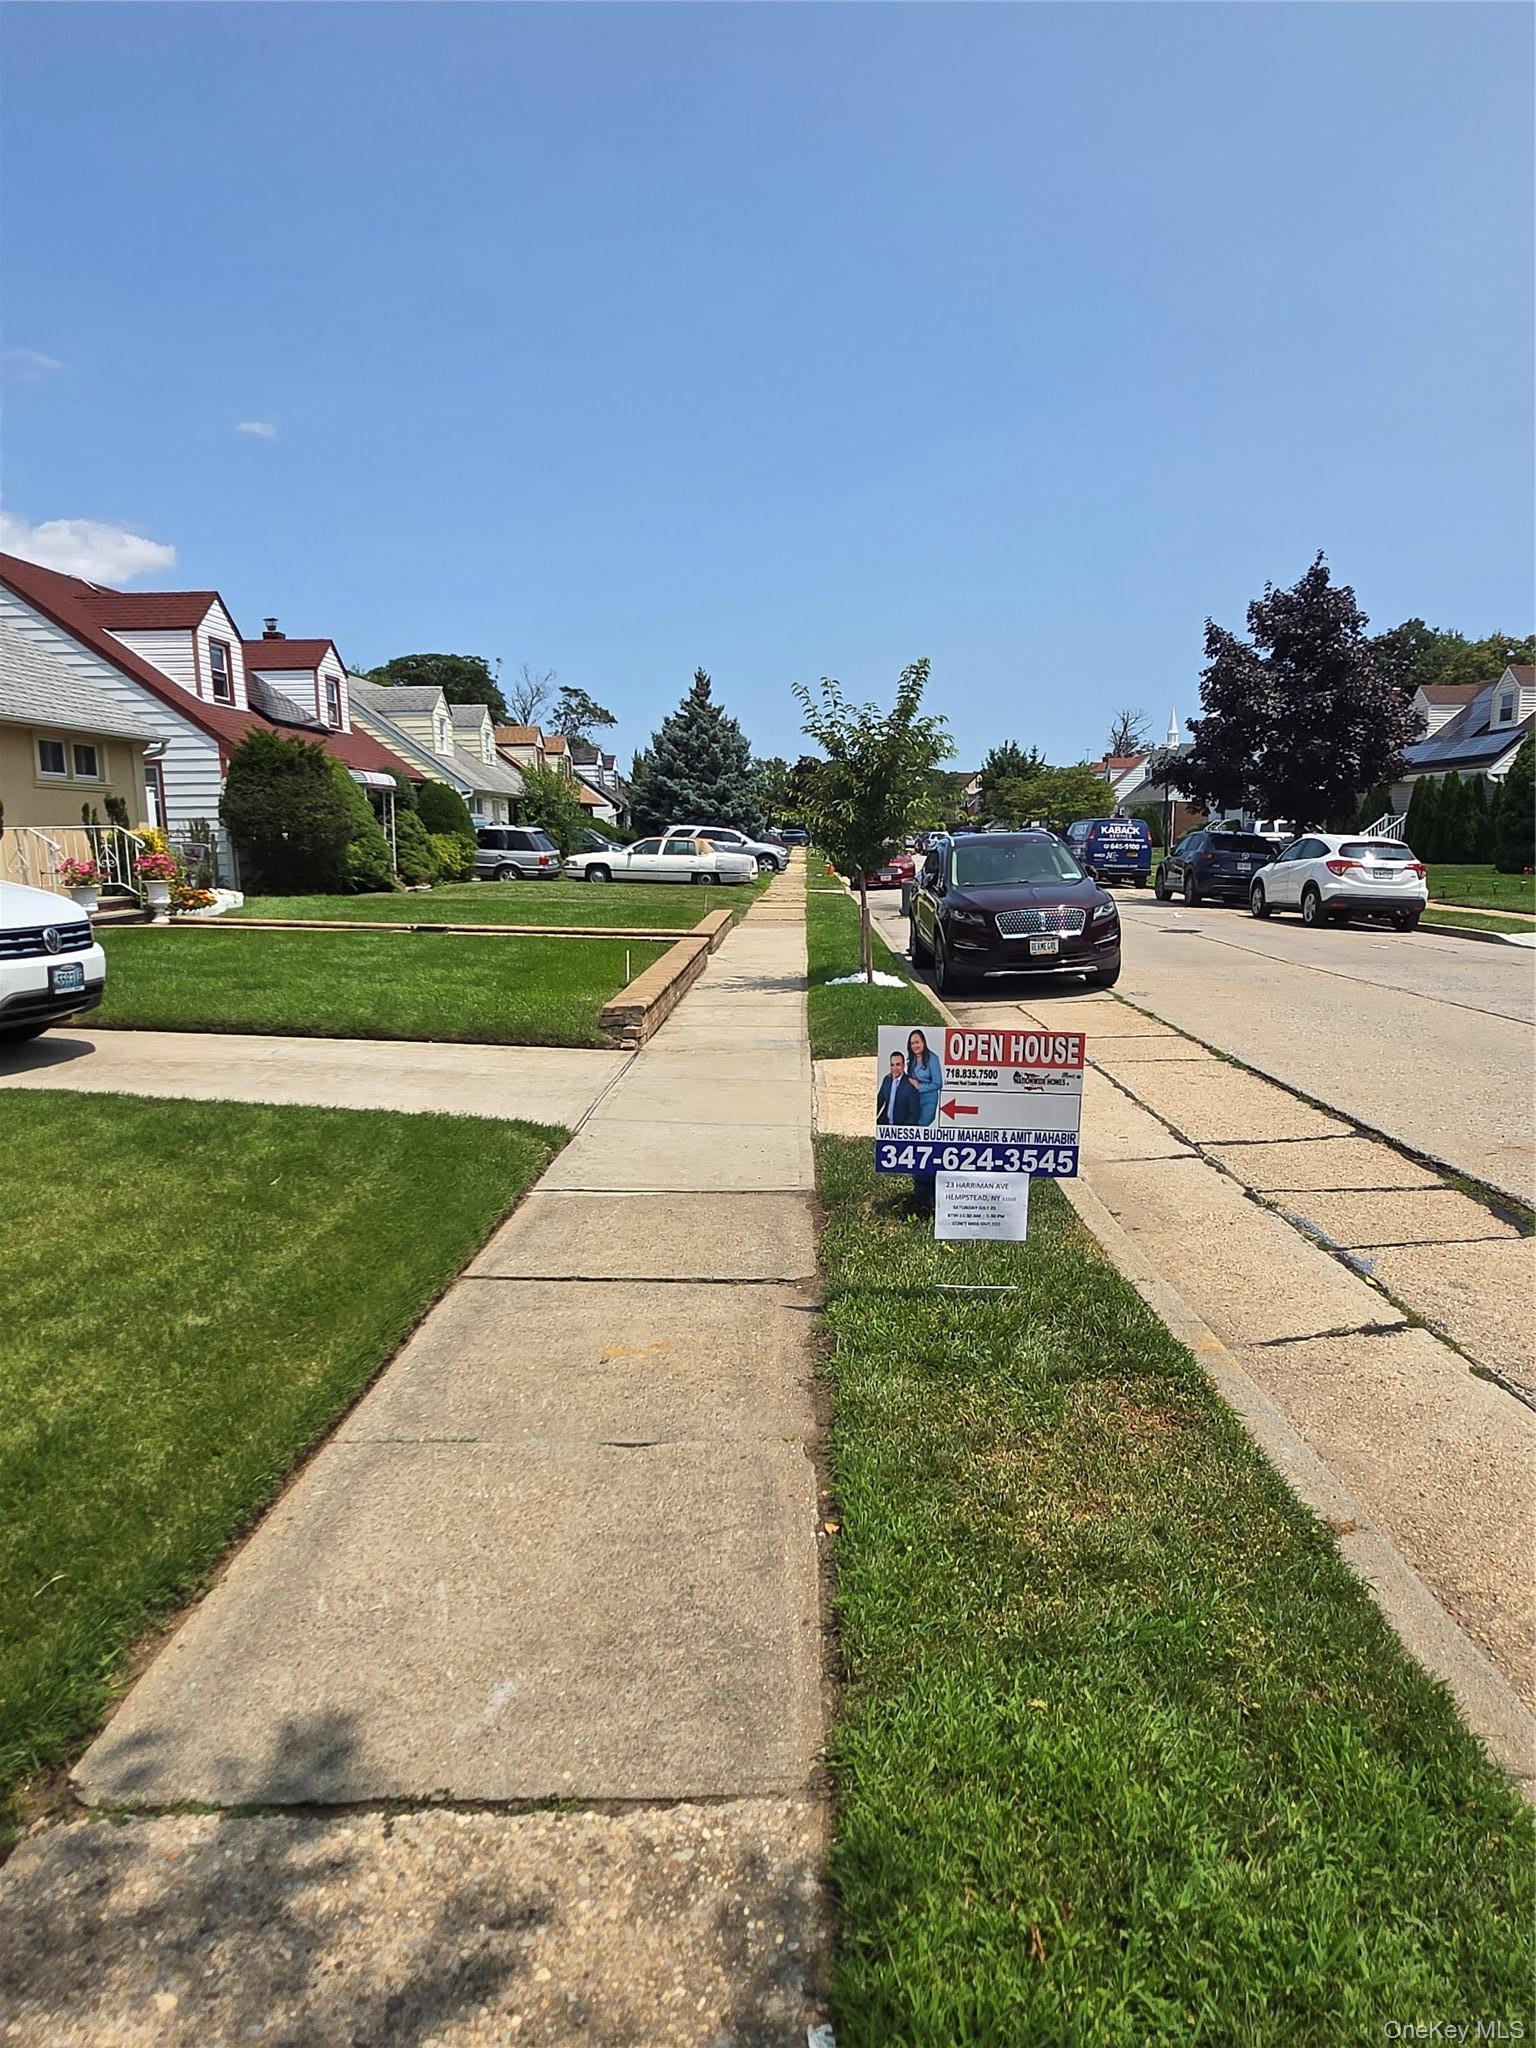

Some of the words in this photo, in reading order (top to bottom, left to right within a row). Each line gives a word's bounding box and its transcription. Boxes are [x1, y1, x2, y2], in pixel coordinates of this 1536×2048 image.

[1101, 826, 1141, 835] KABACK
[949, 1032, 1004, 1063] OPEN
[1010, 1034, 1080, 1065] HOUSE
[945, 1068, 998, 1080] 718.835.7500
[1047, 1078, 1066, 1086] HOMES
[879, 1127, 922, 1140] VANESSA
[923, 1128, 956, 1141] BUDHU
[958, 1129, 999, 1142] MAHABIR
[1001, 1131, 1009, 1142] &
[1009, 1131, 1032, 1143] AMIT
[1034, 1132, 1076, 1145] MAHABIR
[880, 1144, 1074, 1174] 347-624-3545
[945, 1193, 989, 1202] HEMPSTEAD,
